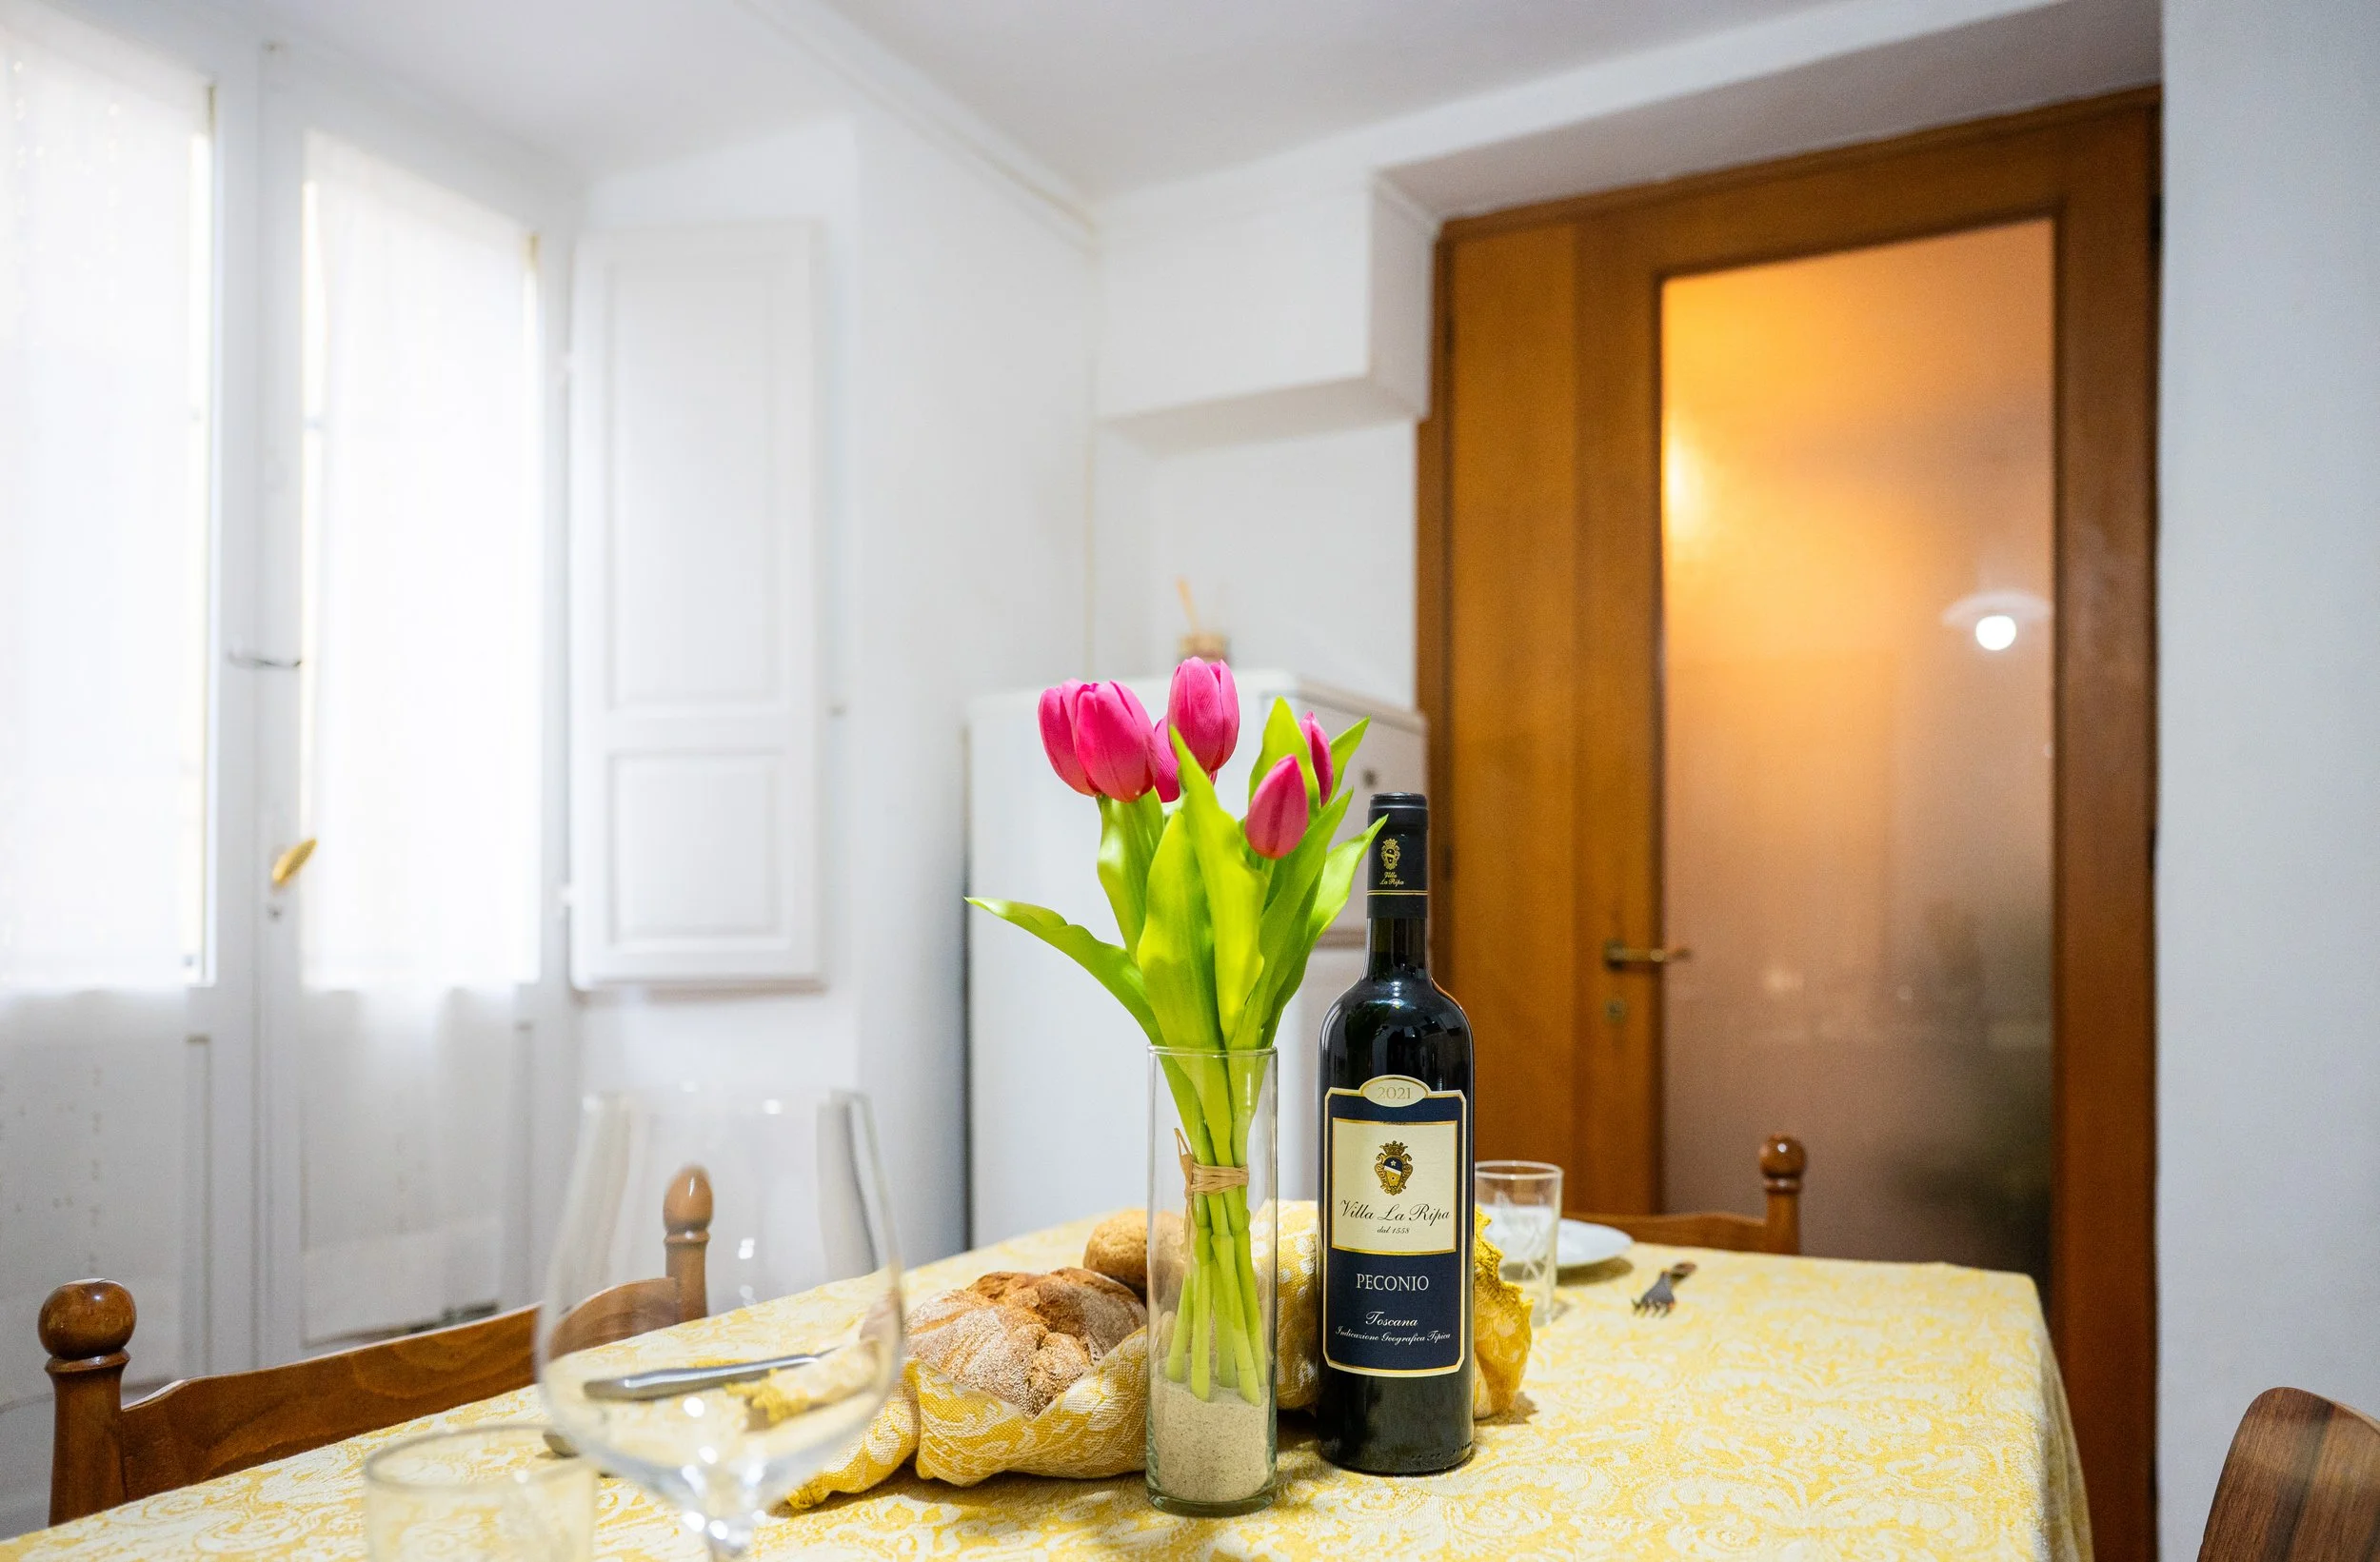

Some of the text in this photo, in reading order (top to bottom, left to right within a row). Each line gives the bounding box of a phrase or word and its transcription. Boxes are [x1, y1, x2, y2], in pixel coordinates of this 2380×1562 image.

[1389, 879, 1404, 887] Ripa
[1378, 1087, 1411, 1098] 2021
[1340, 1199, 1450, 1226] Villa La Ripa
[1356, 1274, 1429, 1292] PECONIO
[1365, 1311, 1418, 1327] Toscana
[1335, 1325, 1451, 1345] Indicazione Geografica Tipica
